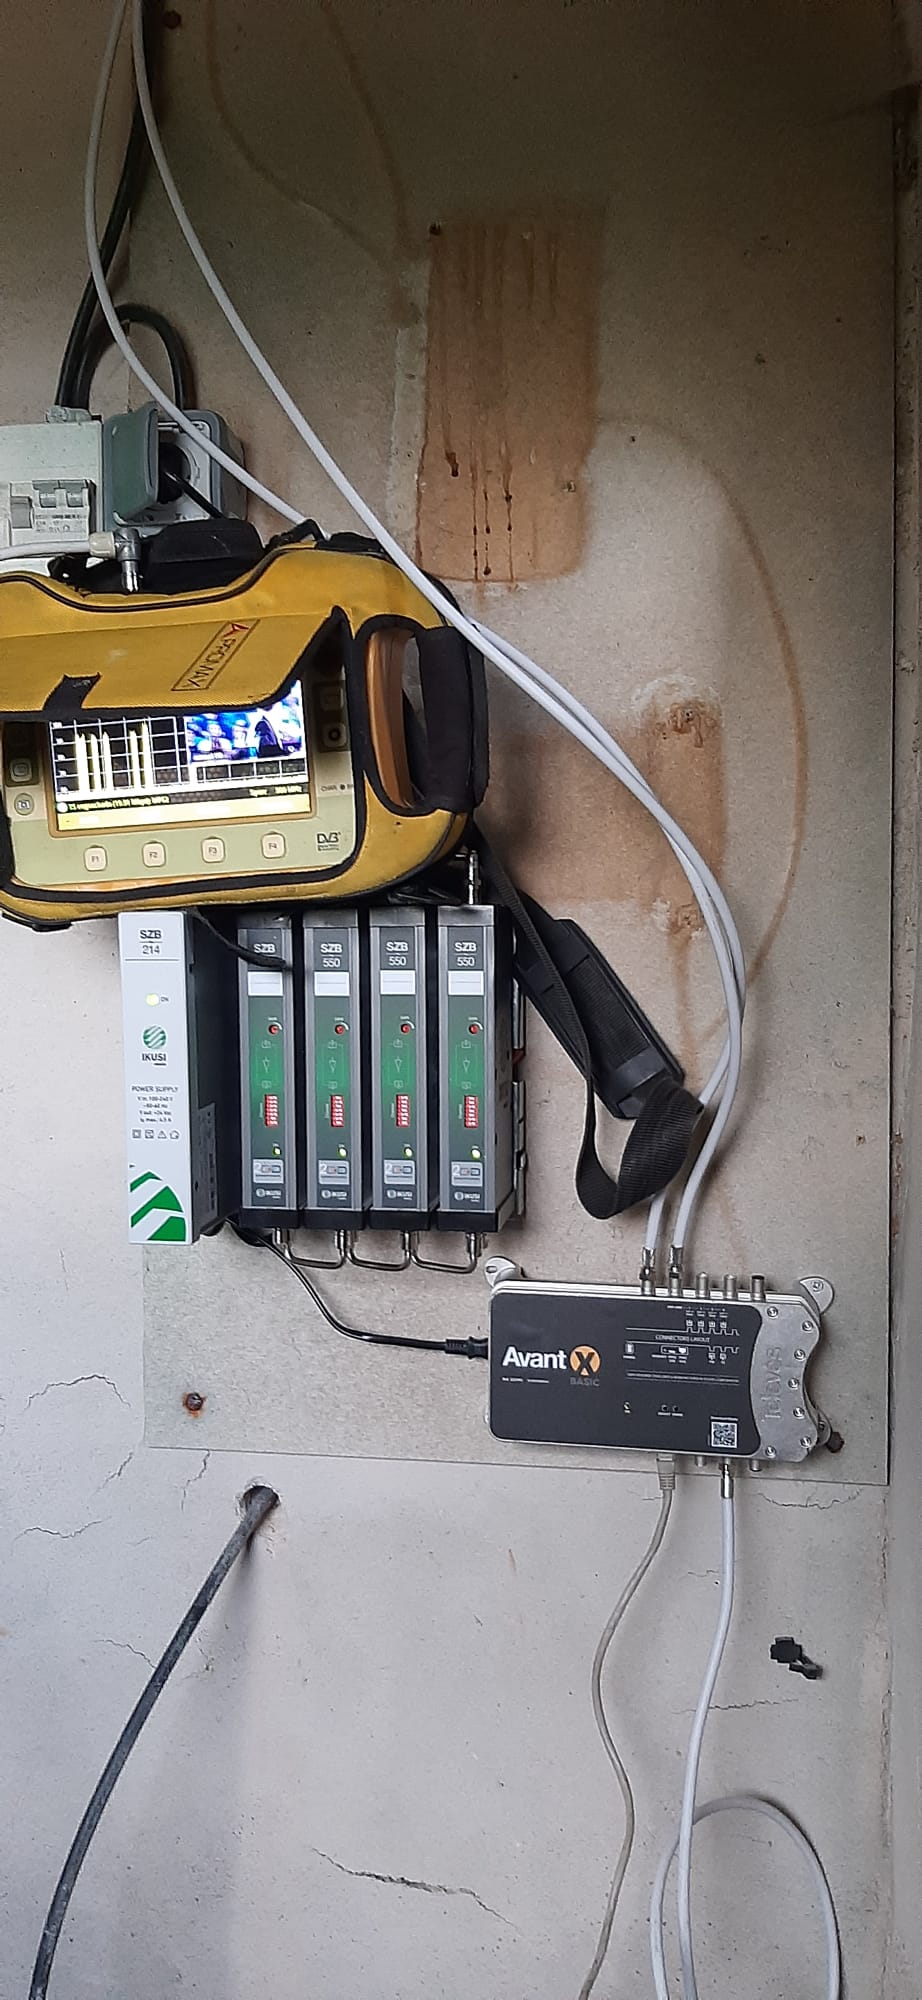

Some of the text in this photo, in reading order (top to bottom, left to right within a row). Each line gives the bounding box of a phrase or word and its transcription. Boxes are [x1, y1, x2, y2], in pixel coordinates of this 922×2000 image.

[208, 846, 218, 854] F3
[139, 929, 162, 939] SZB
[142, 944, 161, 955] 214
[253, 943, 276, 953] SZB
[320, 943, 343, 953] SZB
[386, 941, 409, 952] SZB
[454, 942, 477, 952] SZB
[322, 957, 341, 968] 550
[388, 956, 407, 966] 550
[456, 956, 475, 967] 550
[141, 1053, 167, 1062] IKUSI
[155, 1085, 178, 1093] SUPPLY
[502, 1345, 567, 1370] Avant
[569, 1377, 600, 1387] BASIC
